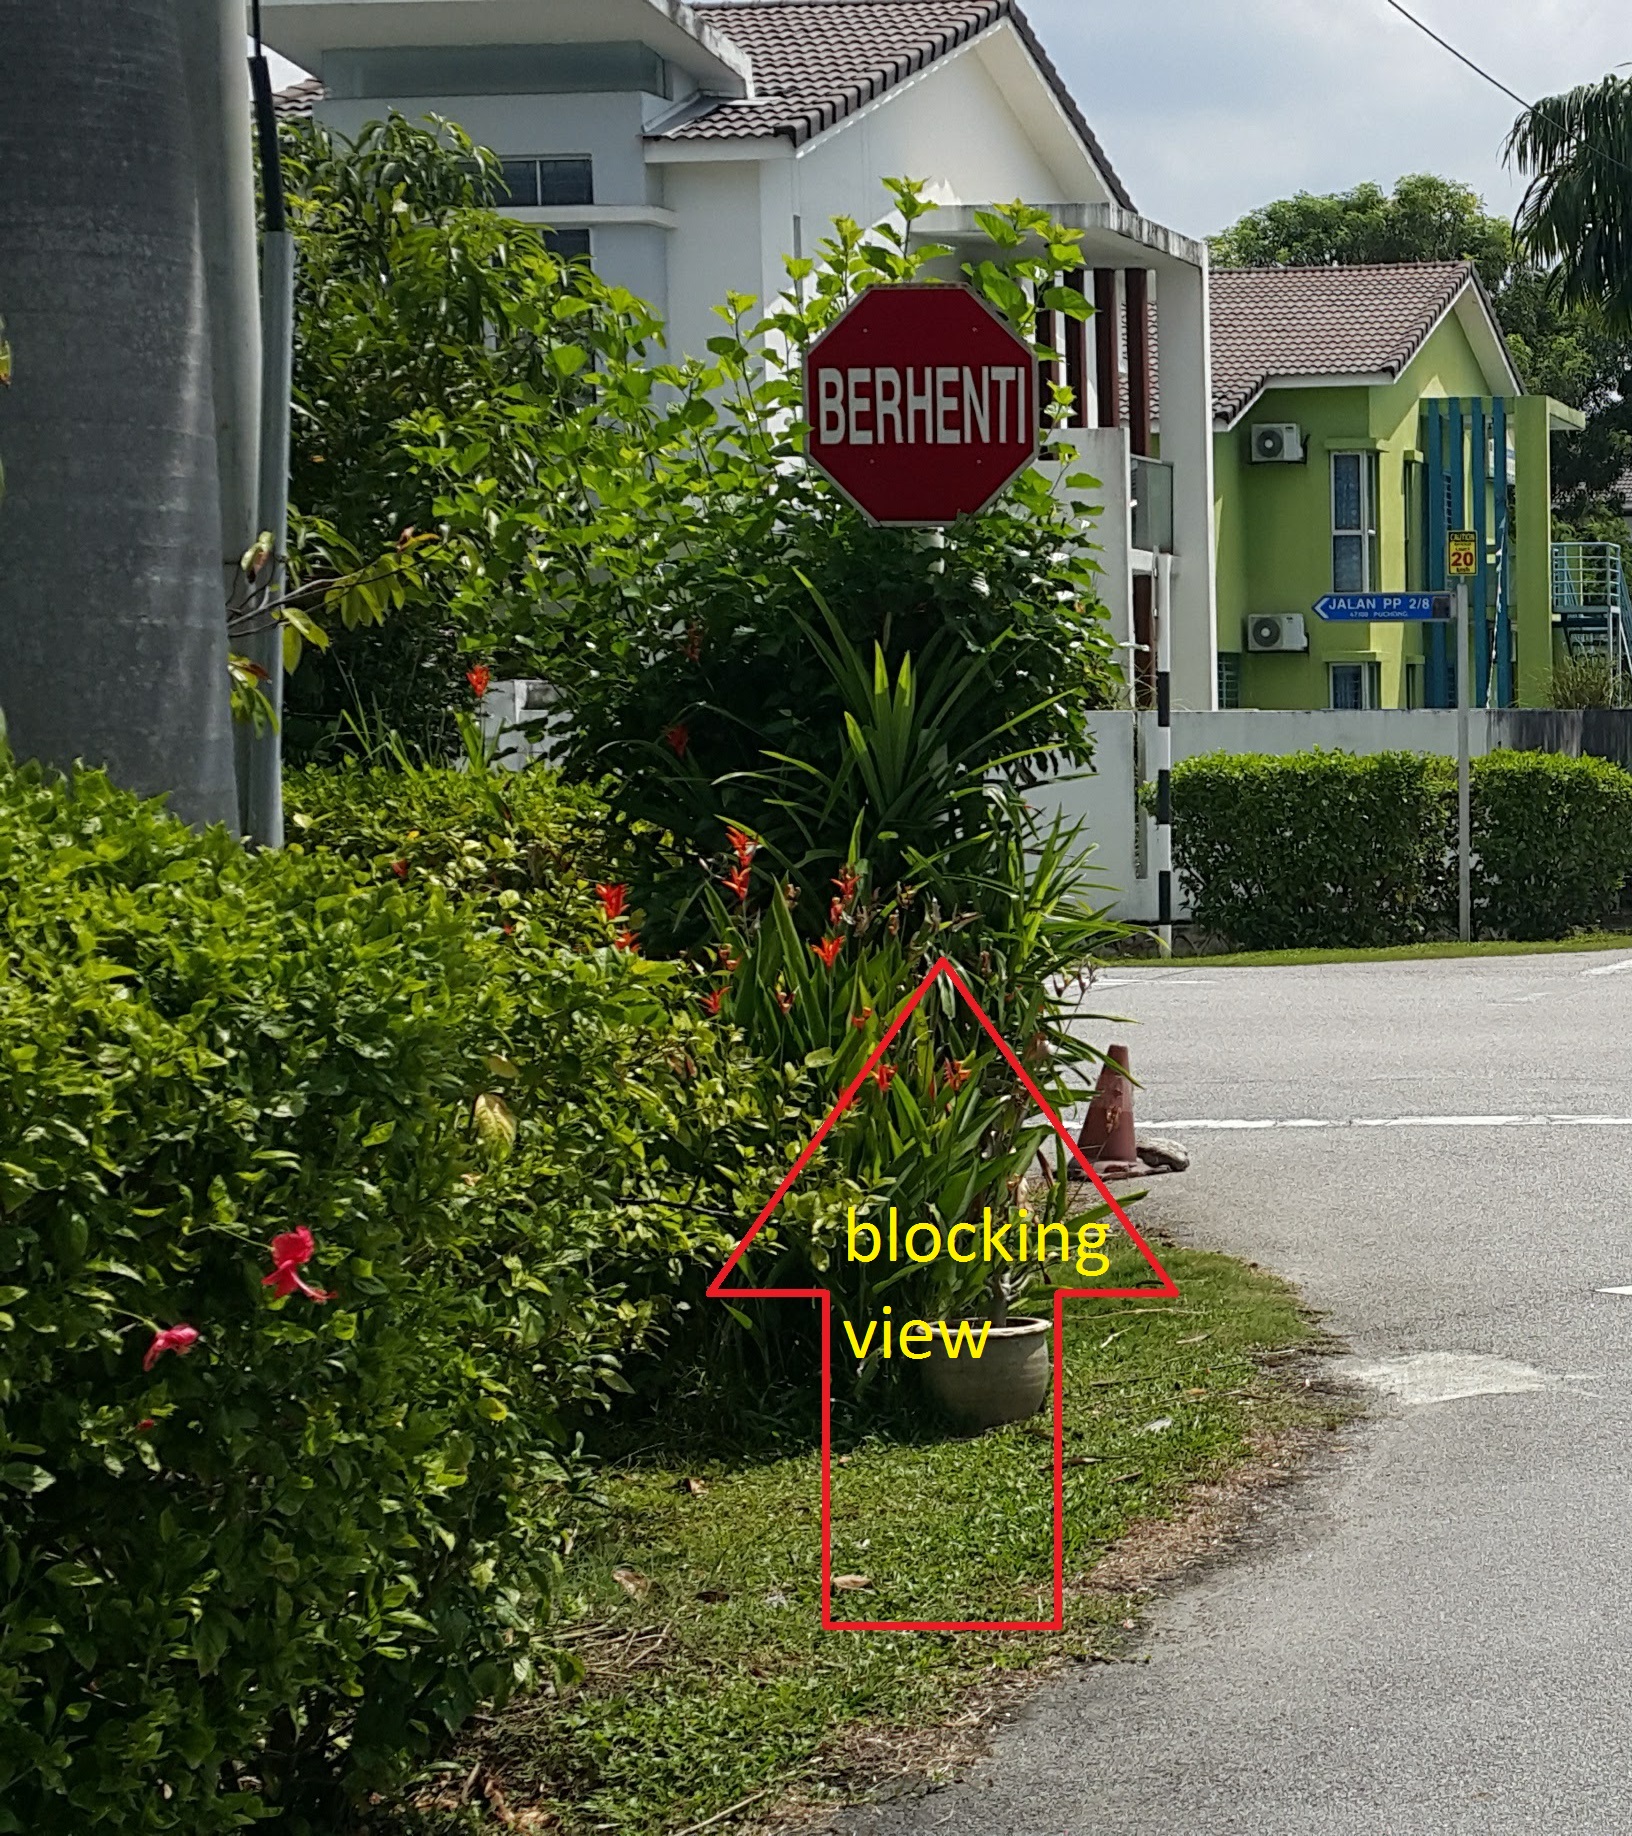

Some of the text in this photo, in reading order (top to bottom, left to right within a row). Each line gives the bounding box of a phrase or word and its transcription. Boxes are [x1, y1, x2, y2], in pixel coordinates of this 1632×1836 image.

[818, 366, 1025, 444] BERHENTI
[1451, 552, 1474, 566] 20
[1329, 598, 1430, 610] JALAN PP 2/8
